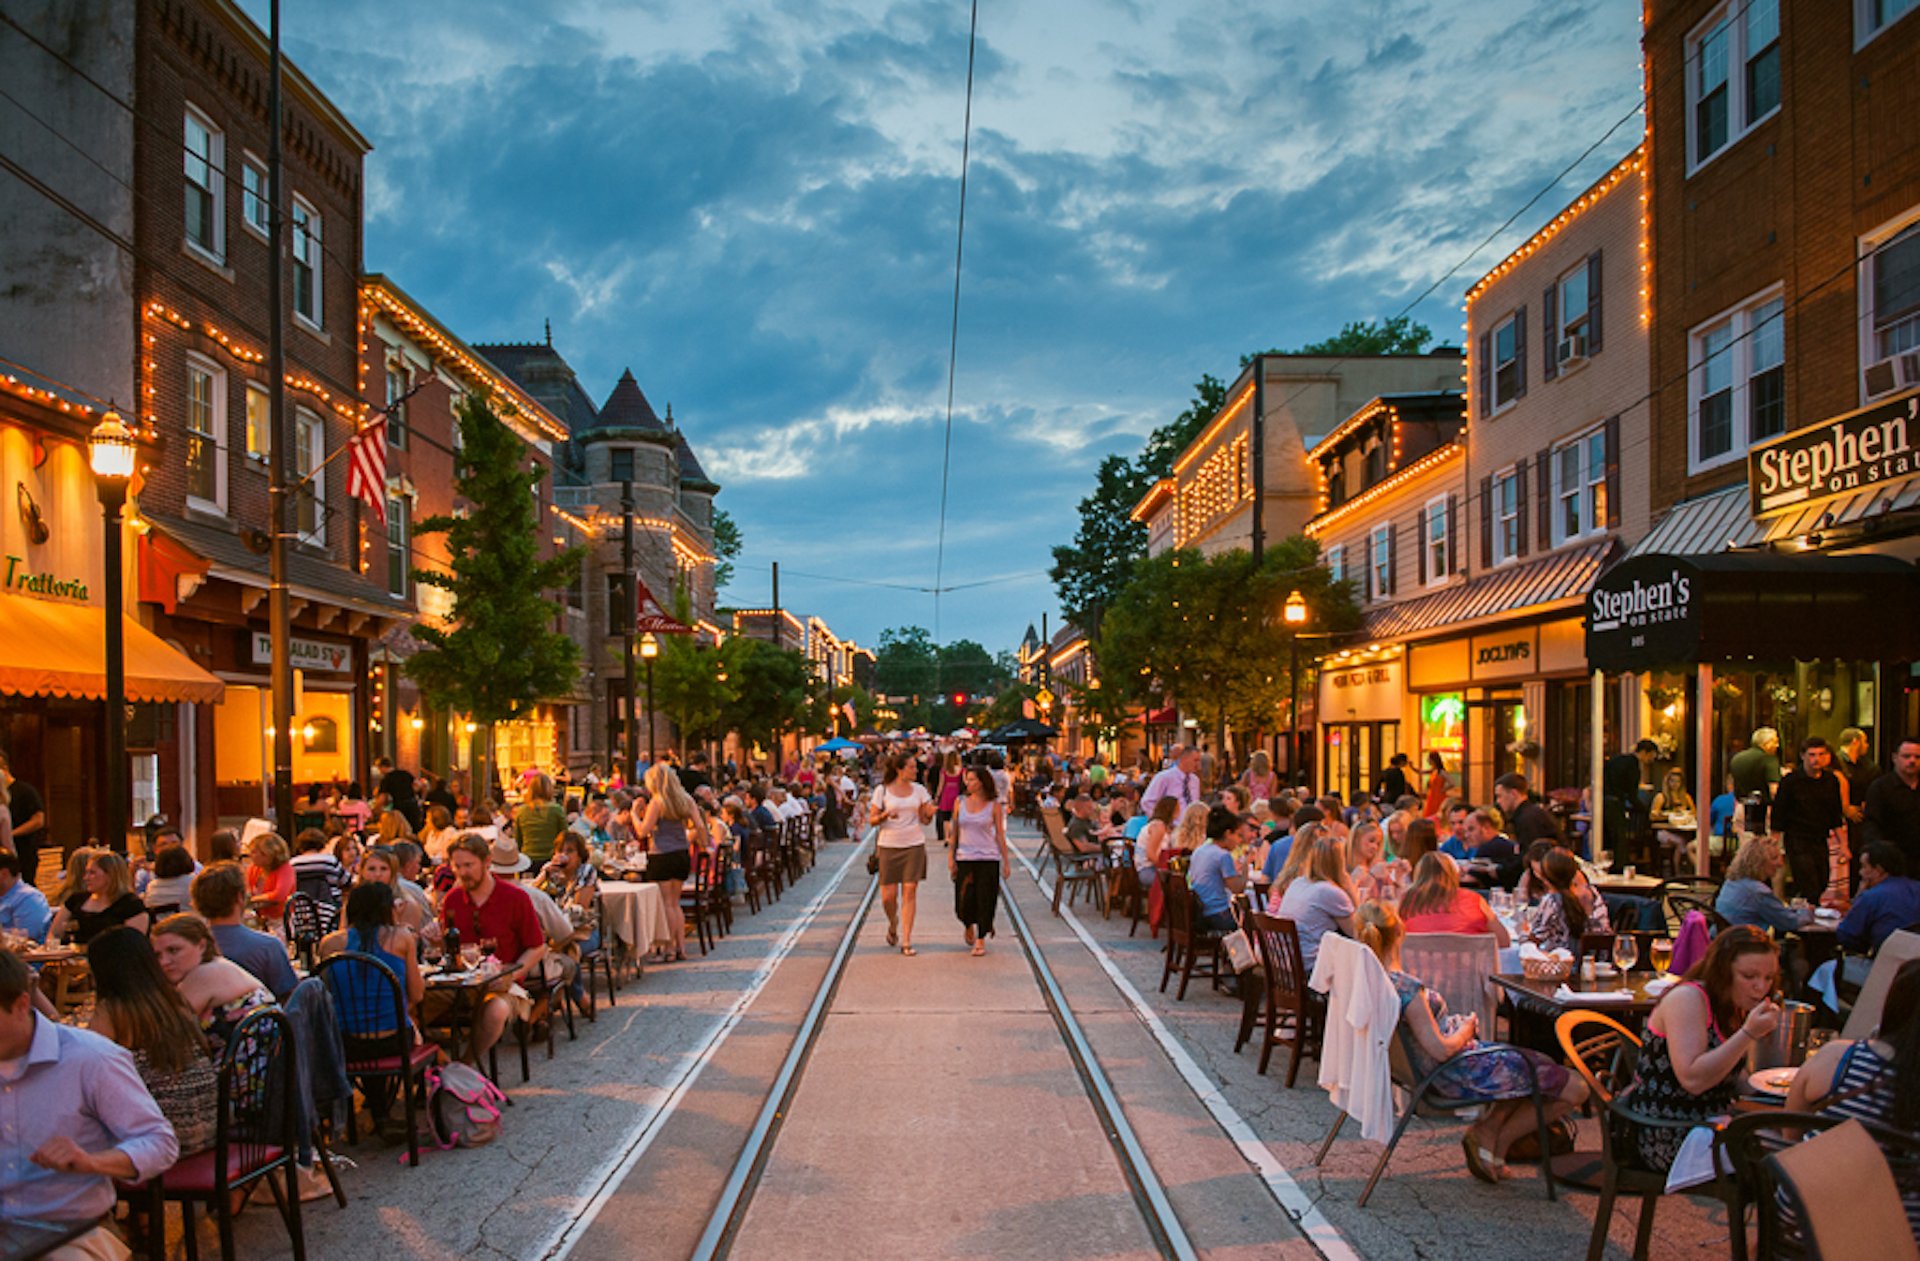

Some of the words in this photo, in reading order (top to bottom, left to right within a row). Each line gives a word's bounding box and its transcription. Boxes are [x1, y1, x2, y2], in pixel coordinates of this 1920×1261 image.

[1829, 472, 1859, 491] on
[6, 555, 88, 600] Trattoria
[1593, 570, 1690, 624] Stephen's
[1630, 614, 1646, 627] on
[1650, 606, 1687, 622] state
